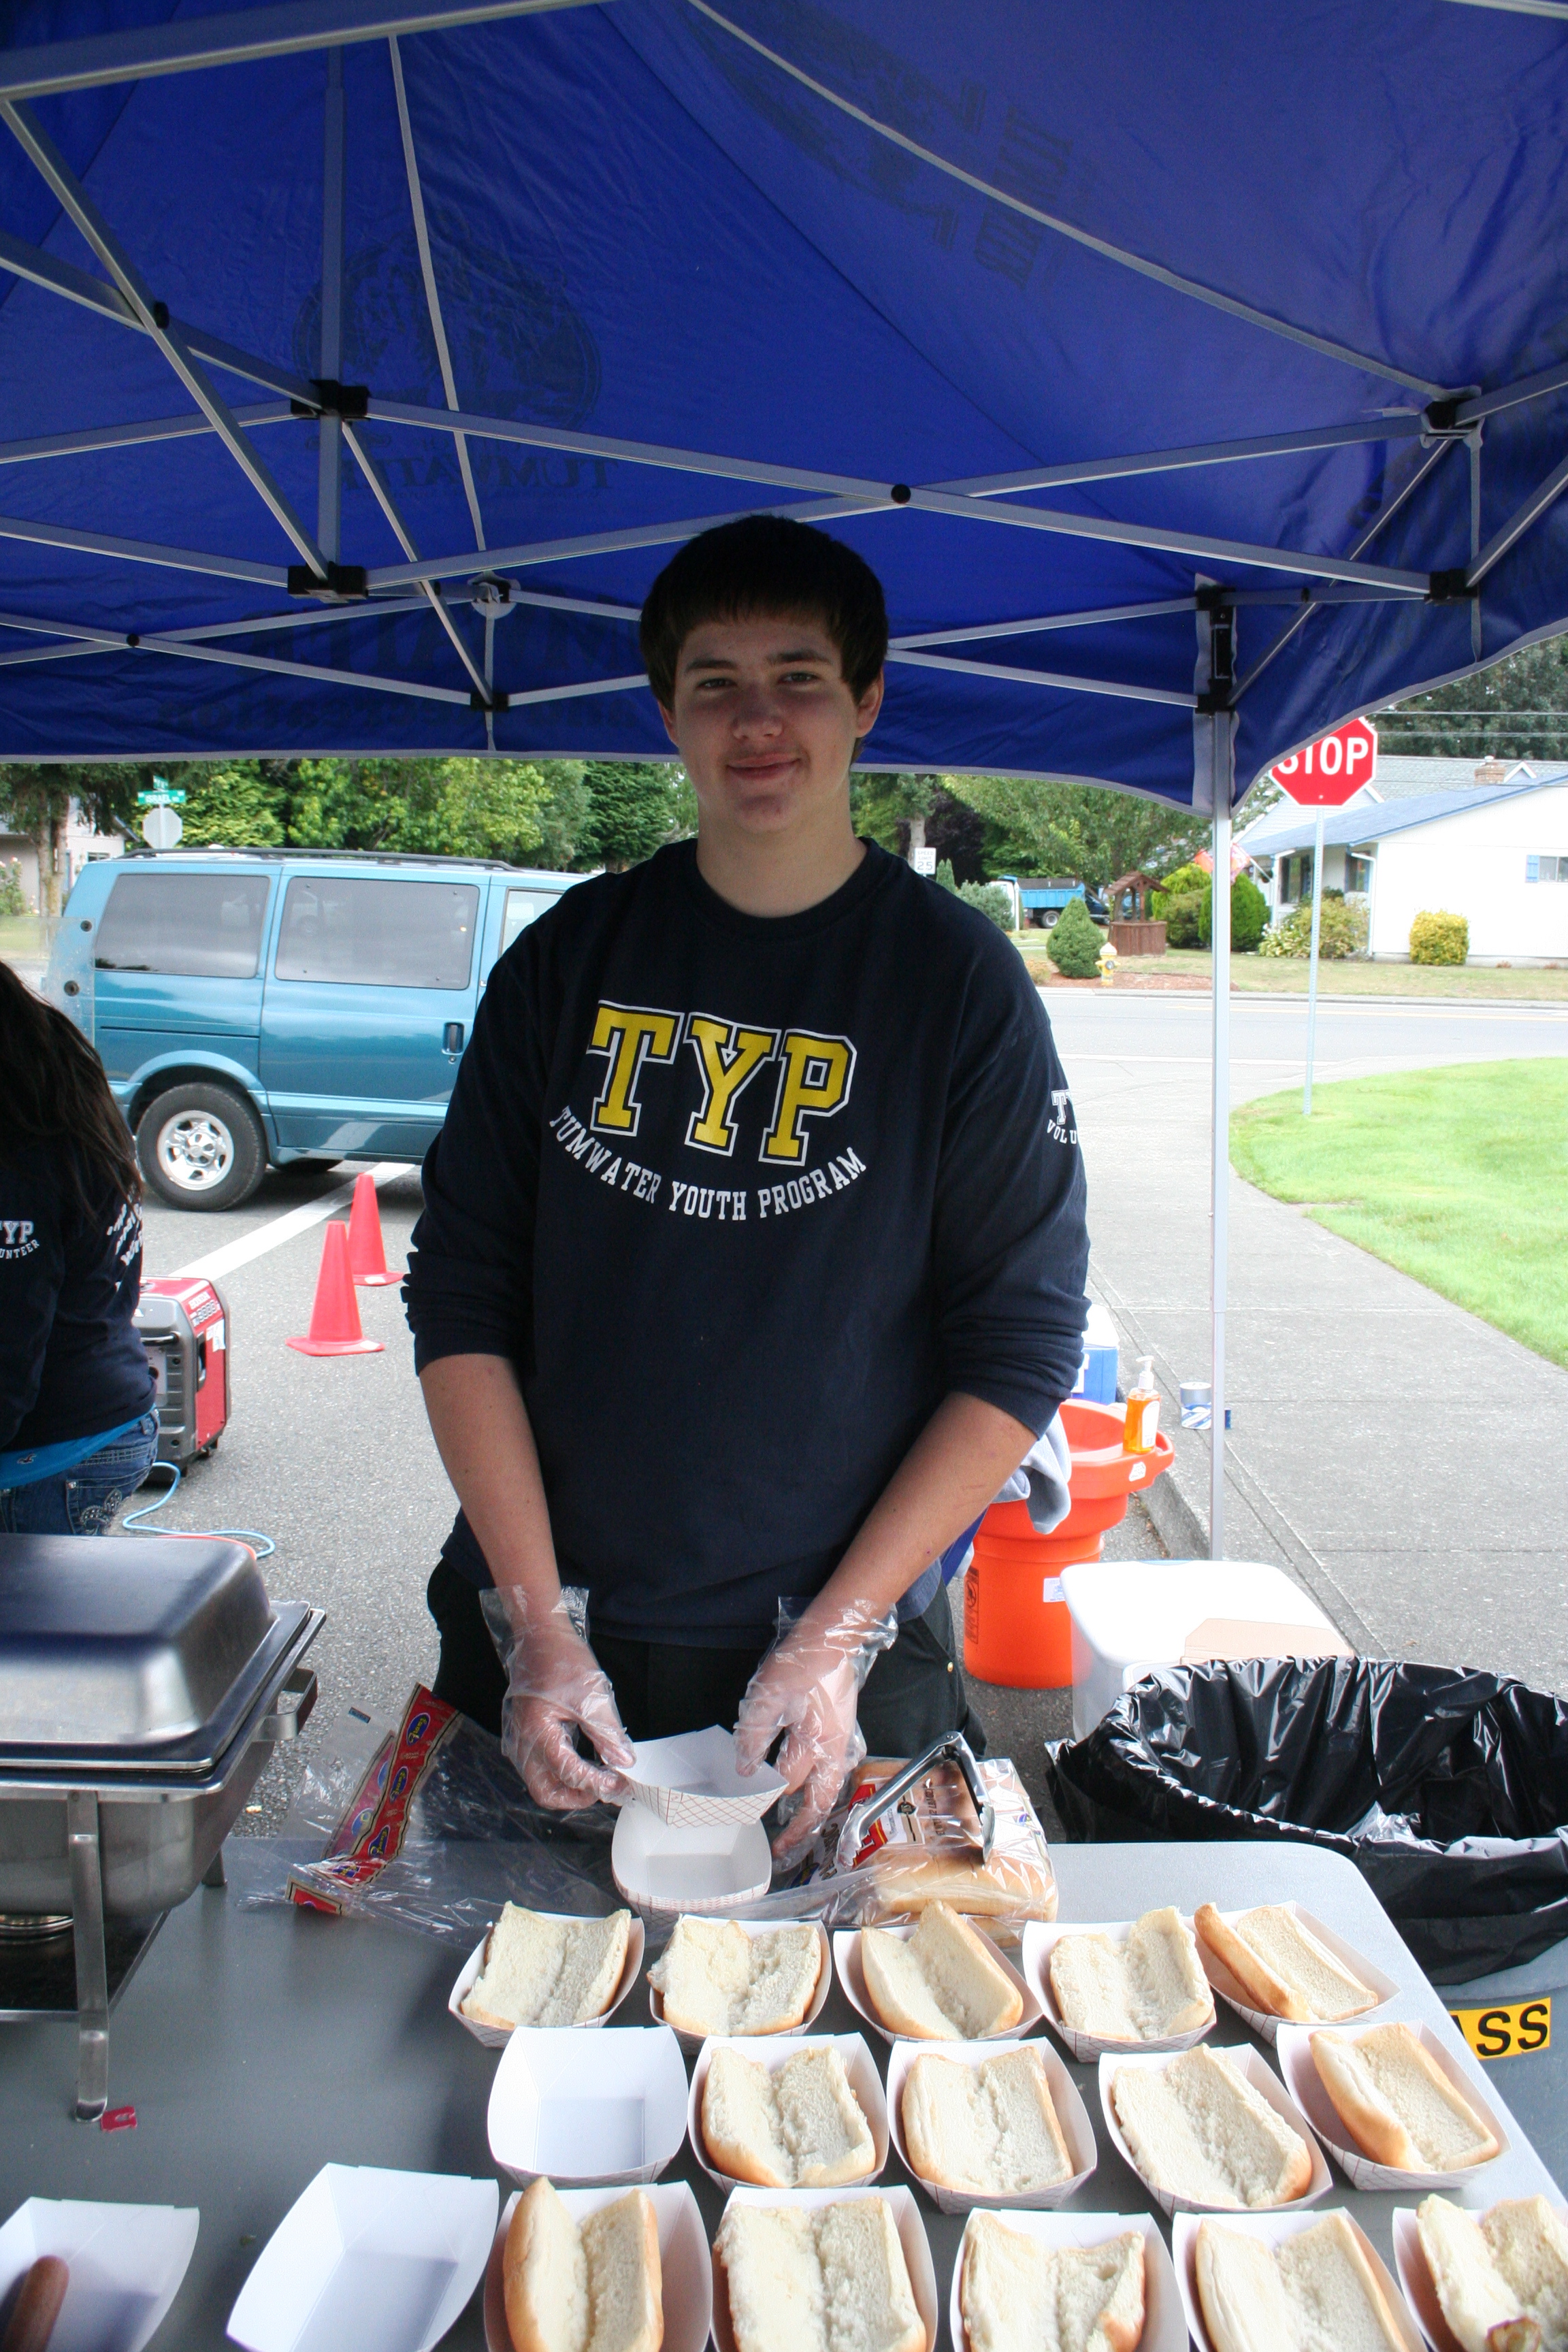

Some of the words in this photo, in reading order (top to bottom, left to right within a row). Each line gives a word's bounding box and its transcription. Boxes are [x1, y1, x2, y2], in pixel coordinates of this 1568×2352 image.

[586, 999, 858, 1166] TYP
[549, 1105, 662, 1204] TUMWATER
[668, 1181, 747, 1220] YOUTH
[757, 1147, 866, 1218] PROGRAM
